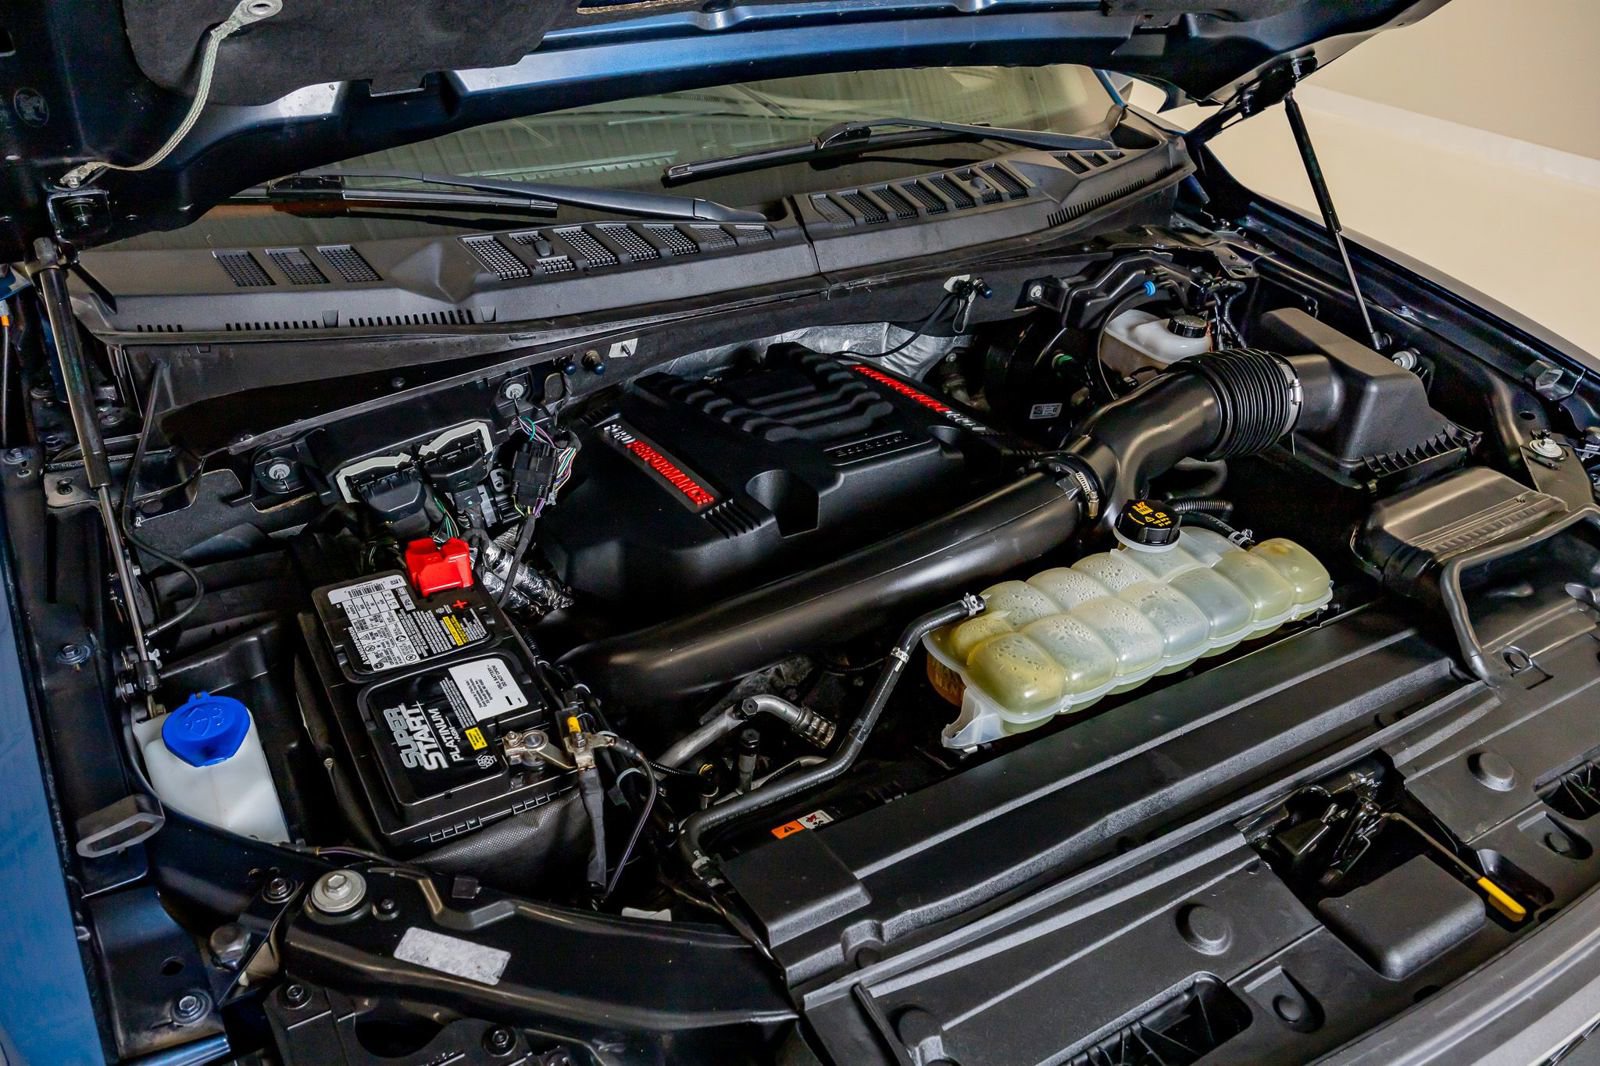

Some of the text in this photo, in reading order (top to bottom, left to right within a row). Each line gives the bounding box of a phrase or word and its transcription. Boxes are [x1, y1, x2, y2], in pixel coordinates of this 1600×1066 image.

[626, 439, 714, 506] PERFORMANCE
[383, 707, 425, 769] SUPER
[399, 702, 449, 771] START
[428, 707, 464, 762] PLATINUM
